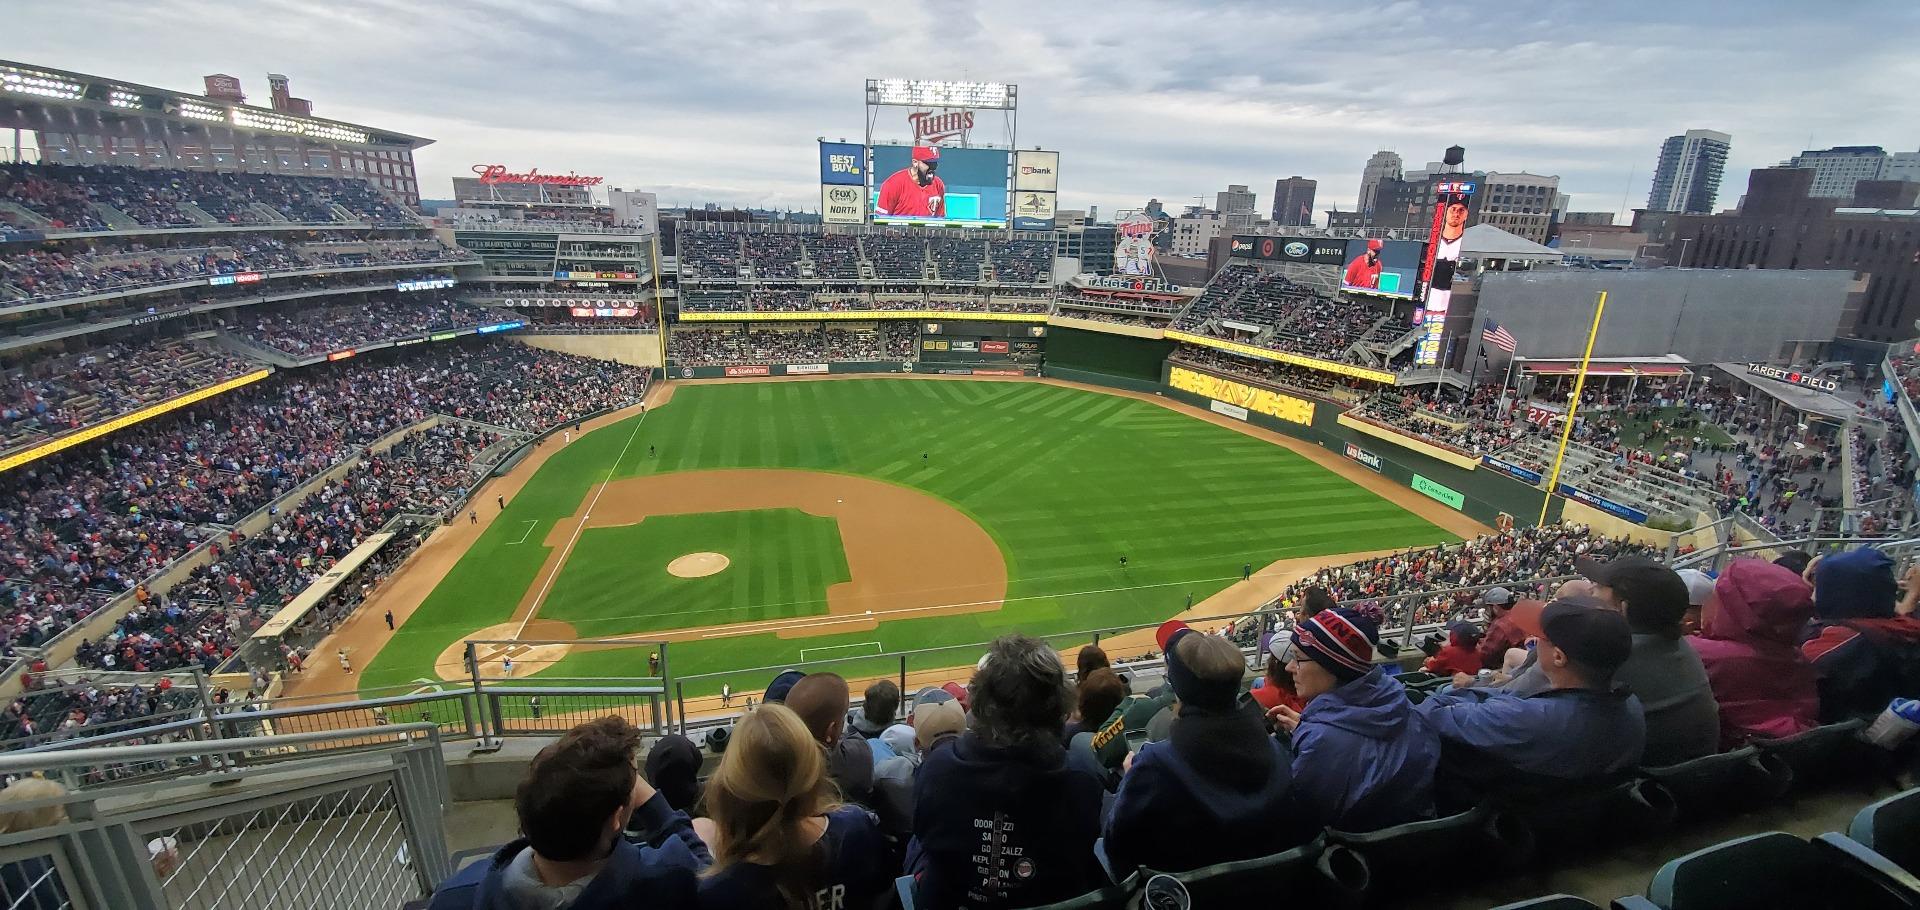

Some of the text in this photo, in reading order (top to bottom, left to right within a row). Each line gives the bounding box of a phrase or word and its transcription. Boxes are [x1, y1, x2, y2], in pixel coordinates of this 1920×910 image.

[908, 109, 974, 141] Twins
[829, 154, 856, 165] BEST
[832, 163, 853, 173] BUY
[835, 189, 851, 198] FOX
[830, 205, 857, 214] NORTH
[1120, 222, 1152, 237] Twins
[1238, 242, 1253, 251] pepsi
[1288, 244, 1304, 255] Ford
[1321, 247, 1343, 256] DELTA
[1088, 279, 1181, 293] TARGET FIELD
[140, 315, 158, 323] DELTA
[1748, 362, 1836, 391] TARGET FIELD
[1527, 407, 1557, 427] 272
[1573, 490, 1601, 505] SUPERCUTS
[973, 818, 1014, 831] ODORZZI
[982, 832, 1007, 843] SAO
[981, 844, 1023, 856] GOZALEZ
[972, 854, 1005, 866] KEPLR
